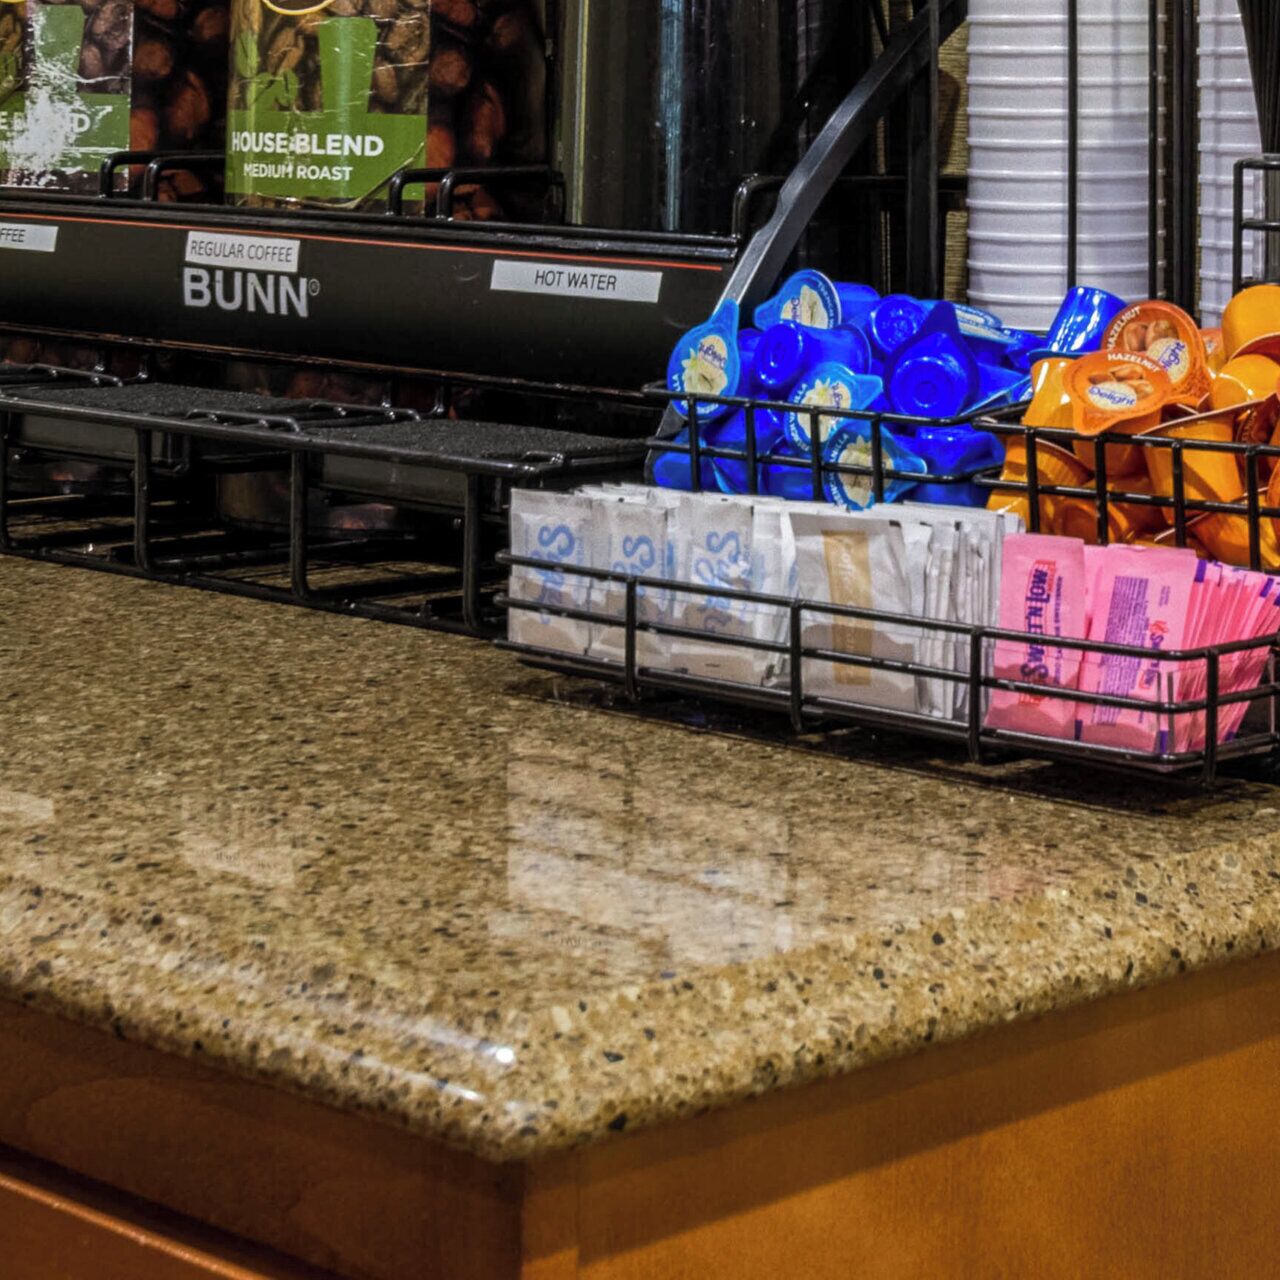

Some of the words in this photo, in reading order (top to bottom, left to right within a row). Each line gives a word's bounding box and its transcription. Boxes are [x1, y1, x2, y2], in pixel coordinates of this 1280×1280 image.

[231, 130, 288, 153] HOUSE
[295, 133, 385, 156] BLEND
[243, 161, 293, 179] MEDIUM
[296, 165, 354, 182] ROAST
[190, 238, 244, 259] REGULAR
[247, 243, 293, 263] COFFEE
[534, 269, 562, 287] HOT
[567, 272, 617, 291] WATER
[182, 266, 309, 318] BUNN
[1107, 352, 1161, 373] HAZELNUT
[1088, 385, 1137, 406] Delight
